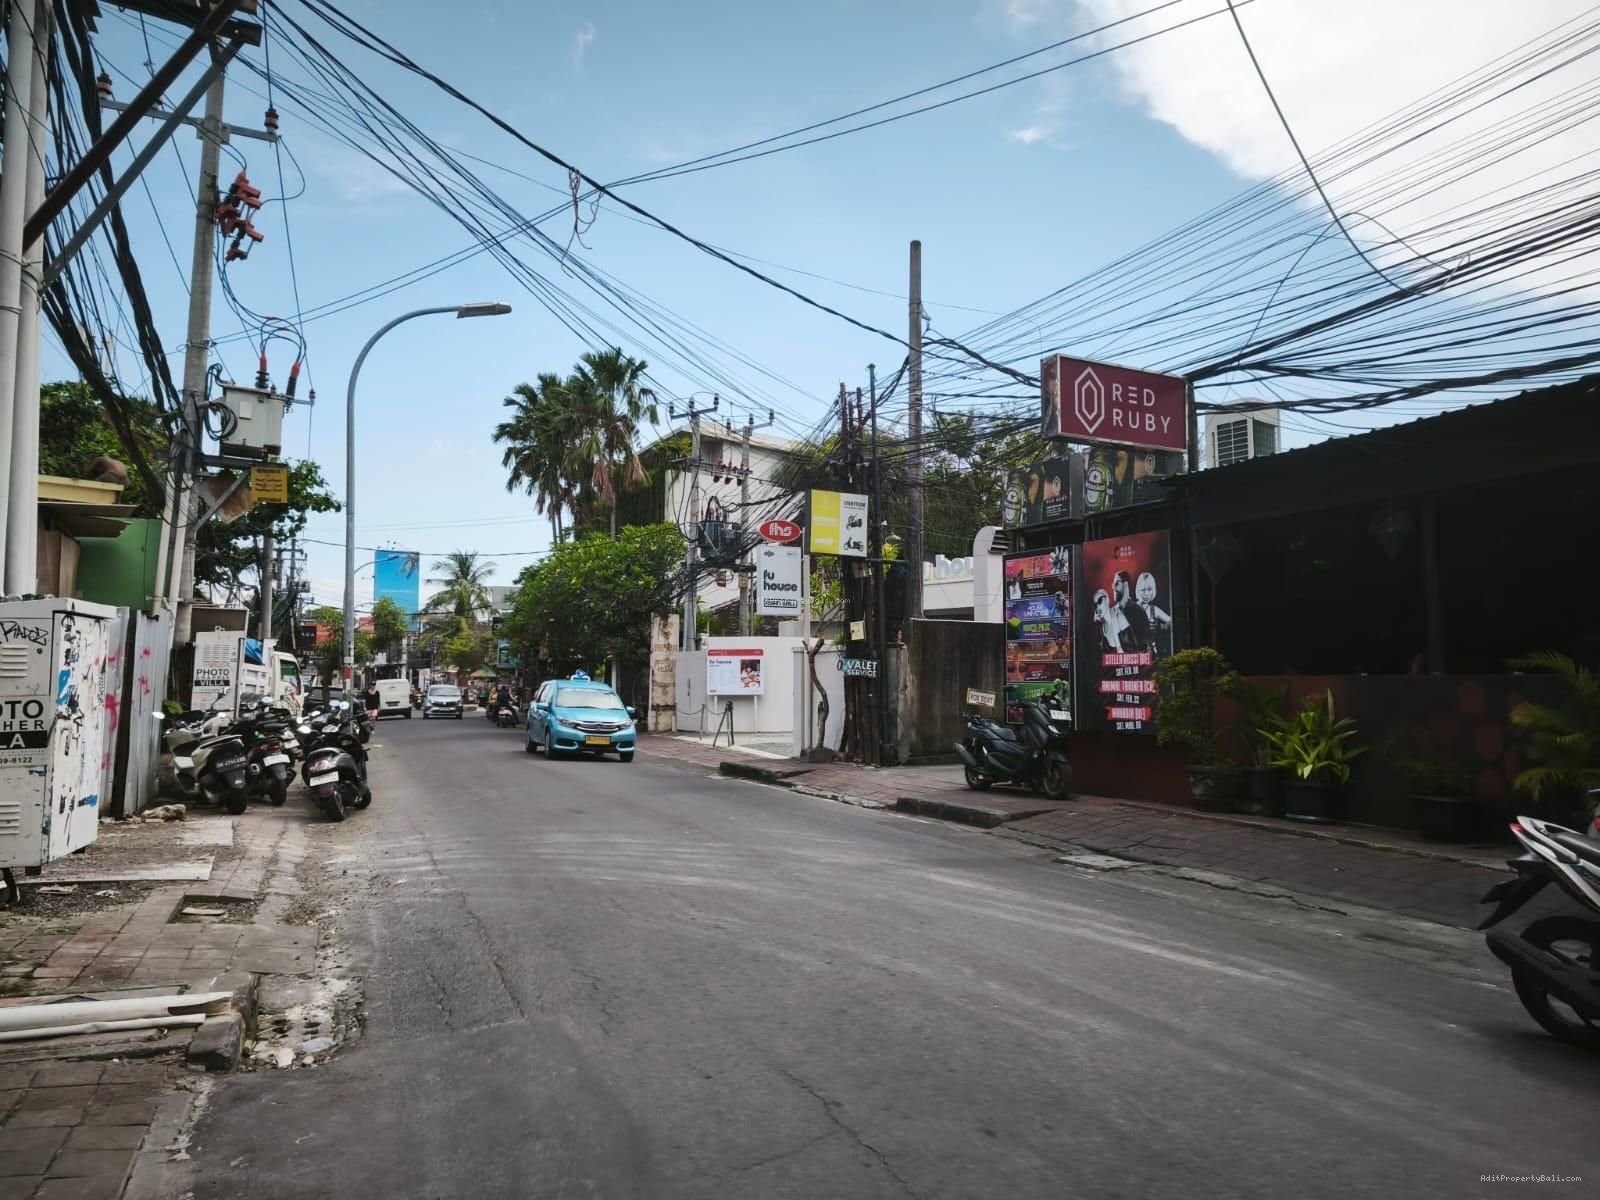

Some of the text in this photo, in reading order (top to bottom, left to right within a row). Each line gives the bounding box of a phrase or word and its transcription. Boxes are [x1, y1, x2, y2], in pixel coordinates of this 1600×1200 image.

[1112, 383, 1155, 407] RED
[1112, 408, 1171, 434] RUBY
[763, 569, 775, 580] fu
[763, 580, 798, 592] house
[847, 660, 878, 671] VALET
[196, 668, 230, 676] PHOTO
[847, 670, 877, 678] SERVICE
[0, 700, 44, 719] TO
